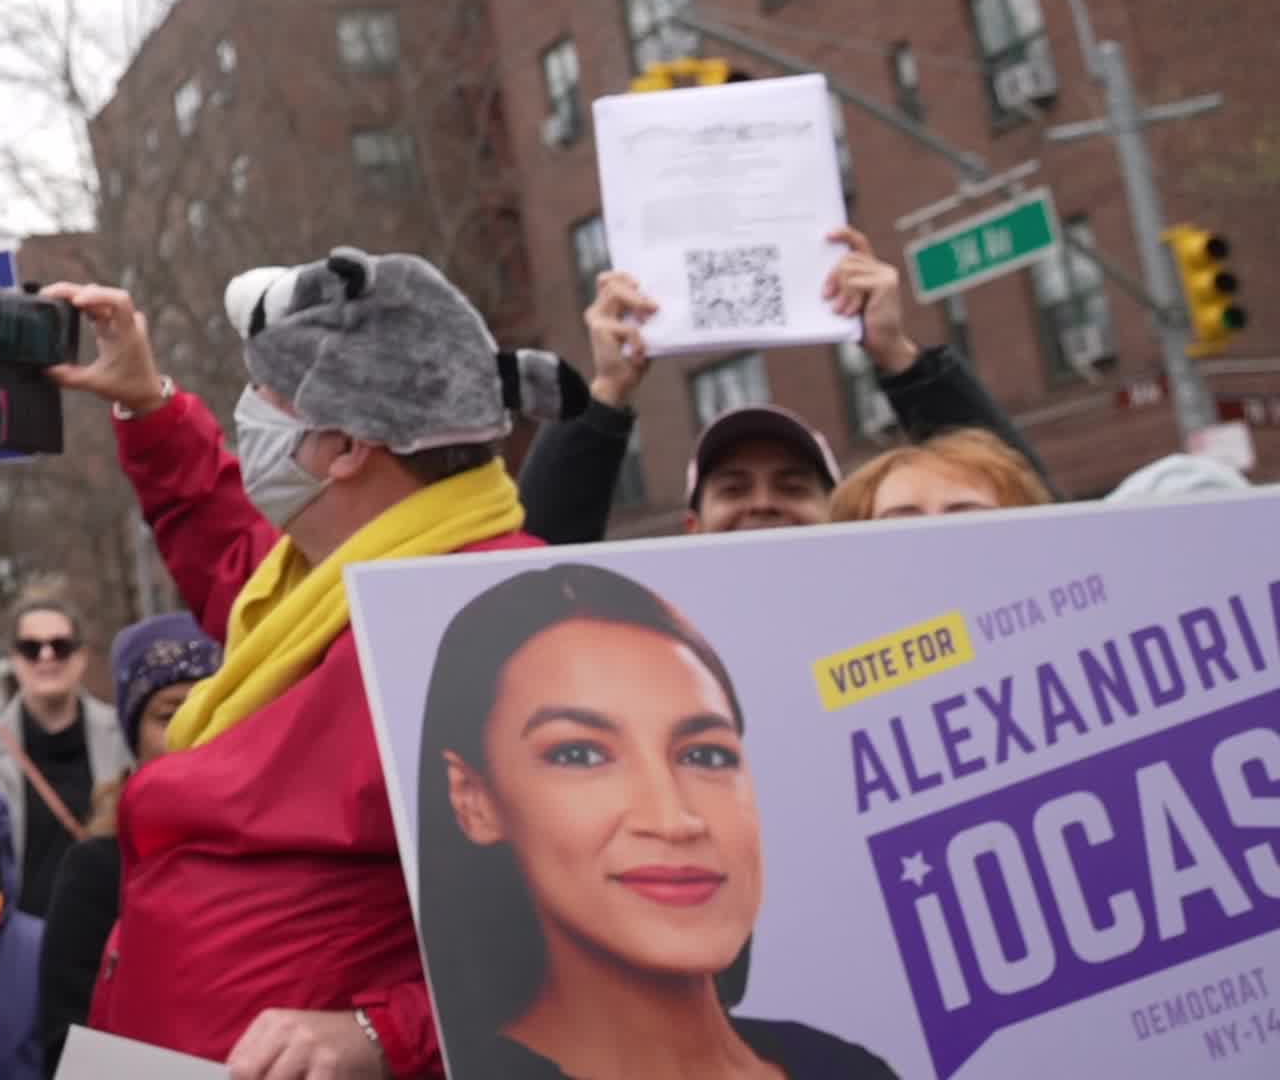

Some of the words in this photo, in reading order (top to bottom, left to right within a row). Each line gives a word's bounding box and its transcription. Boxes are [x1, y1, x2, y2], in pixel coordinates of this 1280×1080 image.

[976, 597, 1046, 642] VOTA
[1048, 573, 1109, 617] POR
[829, 647, 898, 695] VOTE
[901, 626, 956, 671] FOR
[850, 580, 1280, 814] ALEXANDRI
[1130, 967, 1270, 1041] DEMOCRAT
[1203, 1007, 1280, 1062] NY-14
